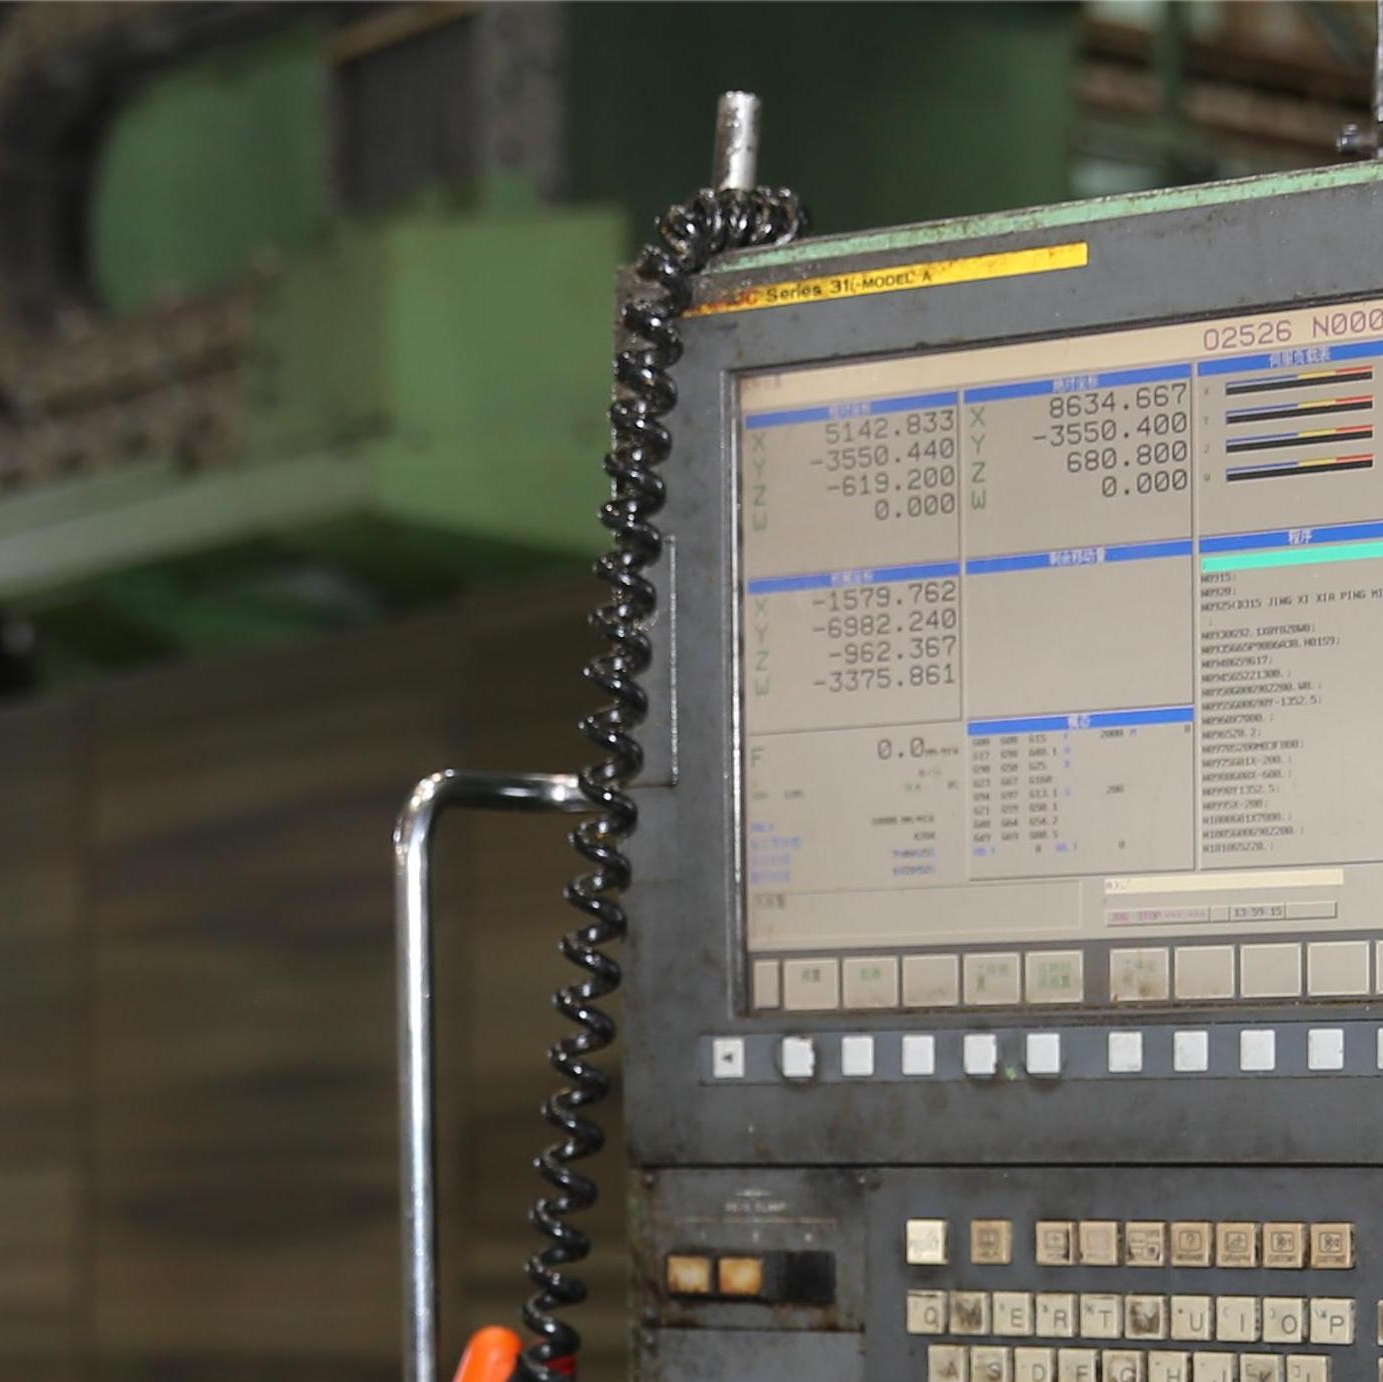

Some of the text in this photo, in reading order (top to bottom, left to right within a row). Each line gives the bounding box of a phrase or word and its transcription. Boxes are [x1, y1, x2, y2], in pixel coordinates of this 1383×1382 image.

[767, 285, 822, 302] Series
[1049, 382, 1187, 419] 8634.667
[824, 409, 955, 445] 5142.833
[1033, 411, 1187, 447] -3550.400
[810, 437, 955, 472] -3550.440
[1067, 440, 1187, 473] 680.800
[826, 465, 955, 497] -619.200
[1102, 469, 1187, 497] 0.000
[874, 492, 955, 521] 0.000
[812, 580, 956, 612] -1579.762
[812, 608, 957, 639] -6982.240
[829, 635, 957, 665] -962.367
[812, 663, 956, 692] -3375.861
[1011, 1308, 1022, 1326] E
[1054, 1310, 1066, 1328] R
[1099, 1310, 1112, 1328] T
[1190, 1314, 1203, 1332] U
[1330, 1315, 1344, 1335] P
[1032, 1364, 1045, 1382] D
